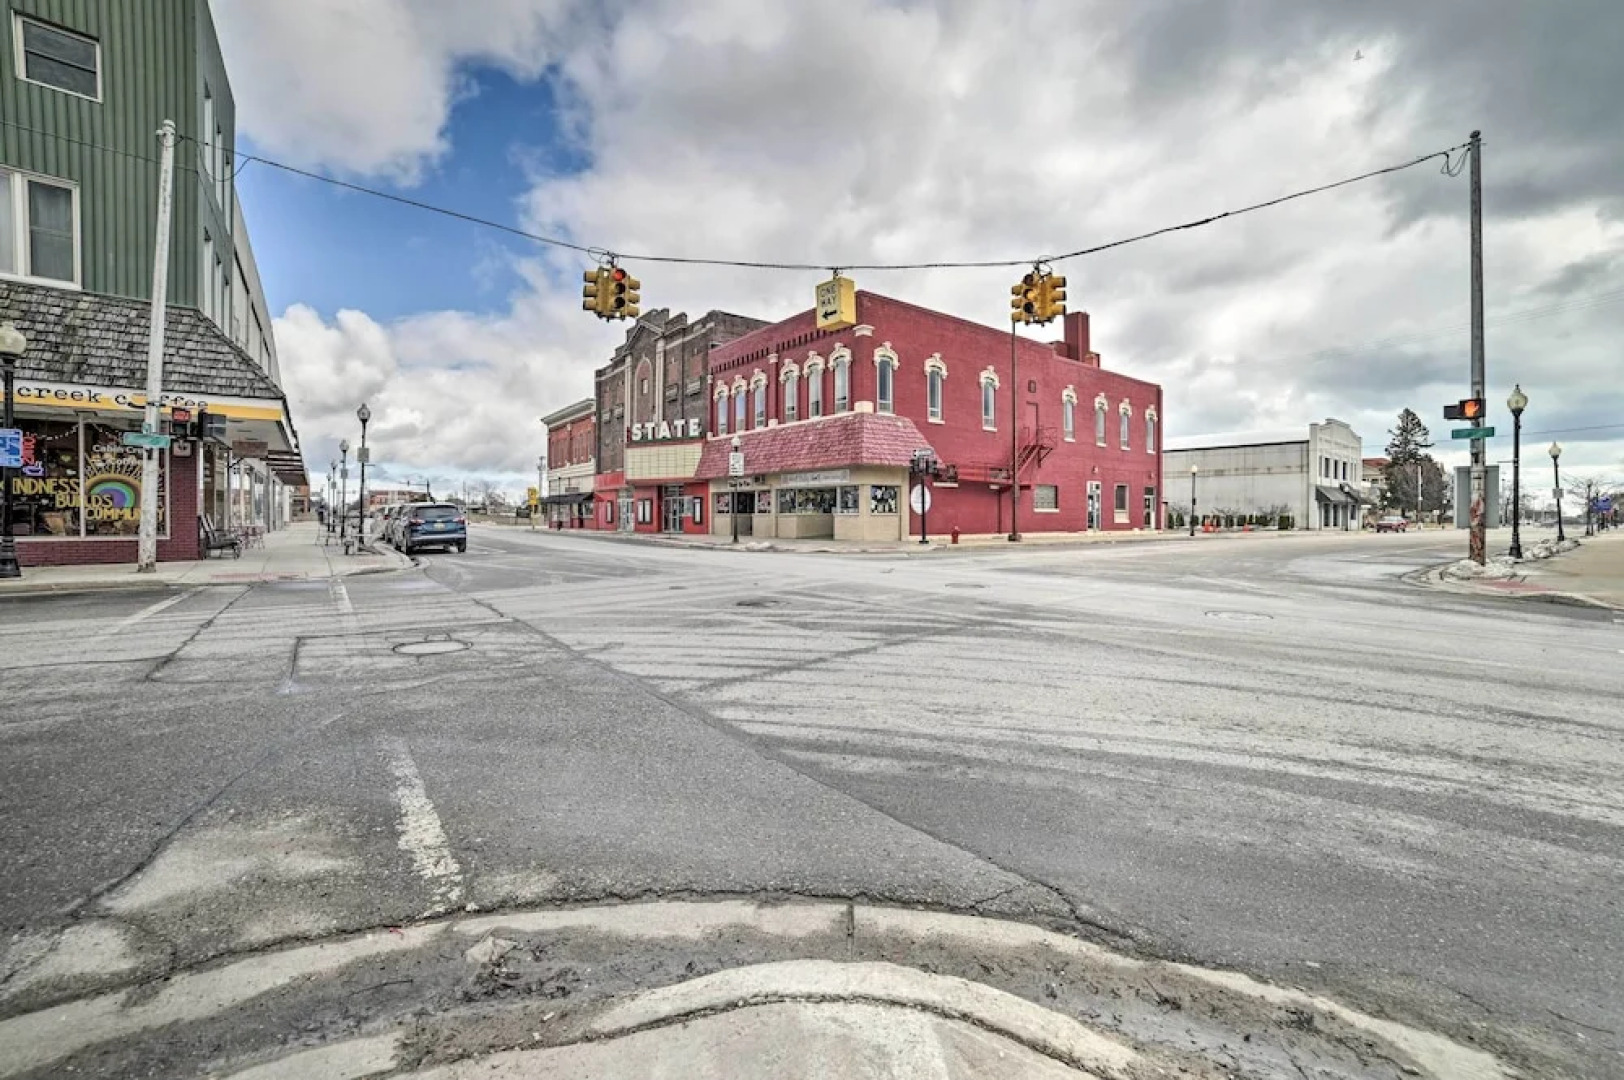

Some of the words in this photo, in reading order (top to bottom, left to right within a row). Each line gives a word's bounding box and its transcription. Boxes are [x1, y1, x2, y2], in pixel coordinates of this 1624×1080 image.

[820, 284, 836, 297] ONE
[820, 295, 836, 308] WAY
[17, 385, 102, 403] creek
[631, 418, 700, 441] STATE
[1, 477, 80, 495] INDNESS
[85, 507, 165, 521] COMMUY
